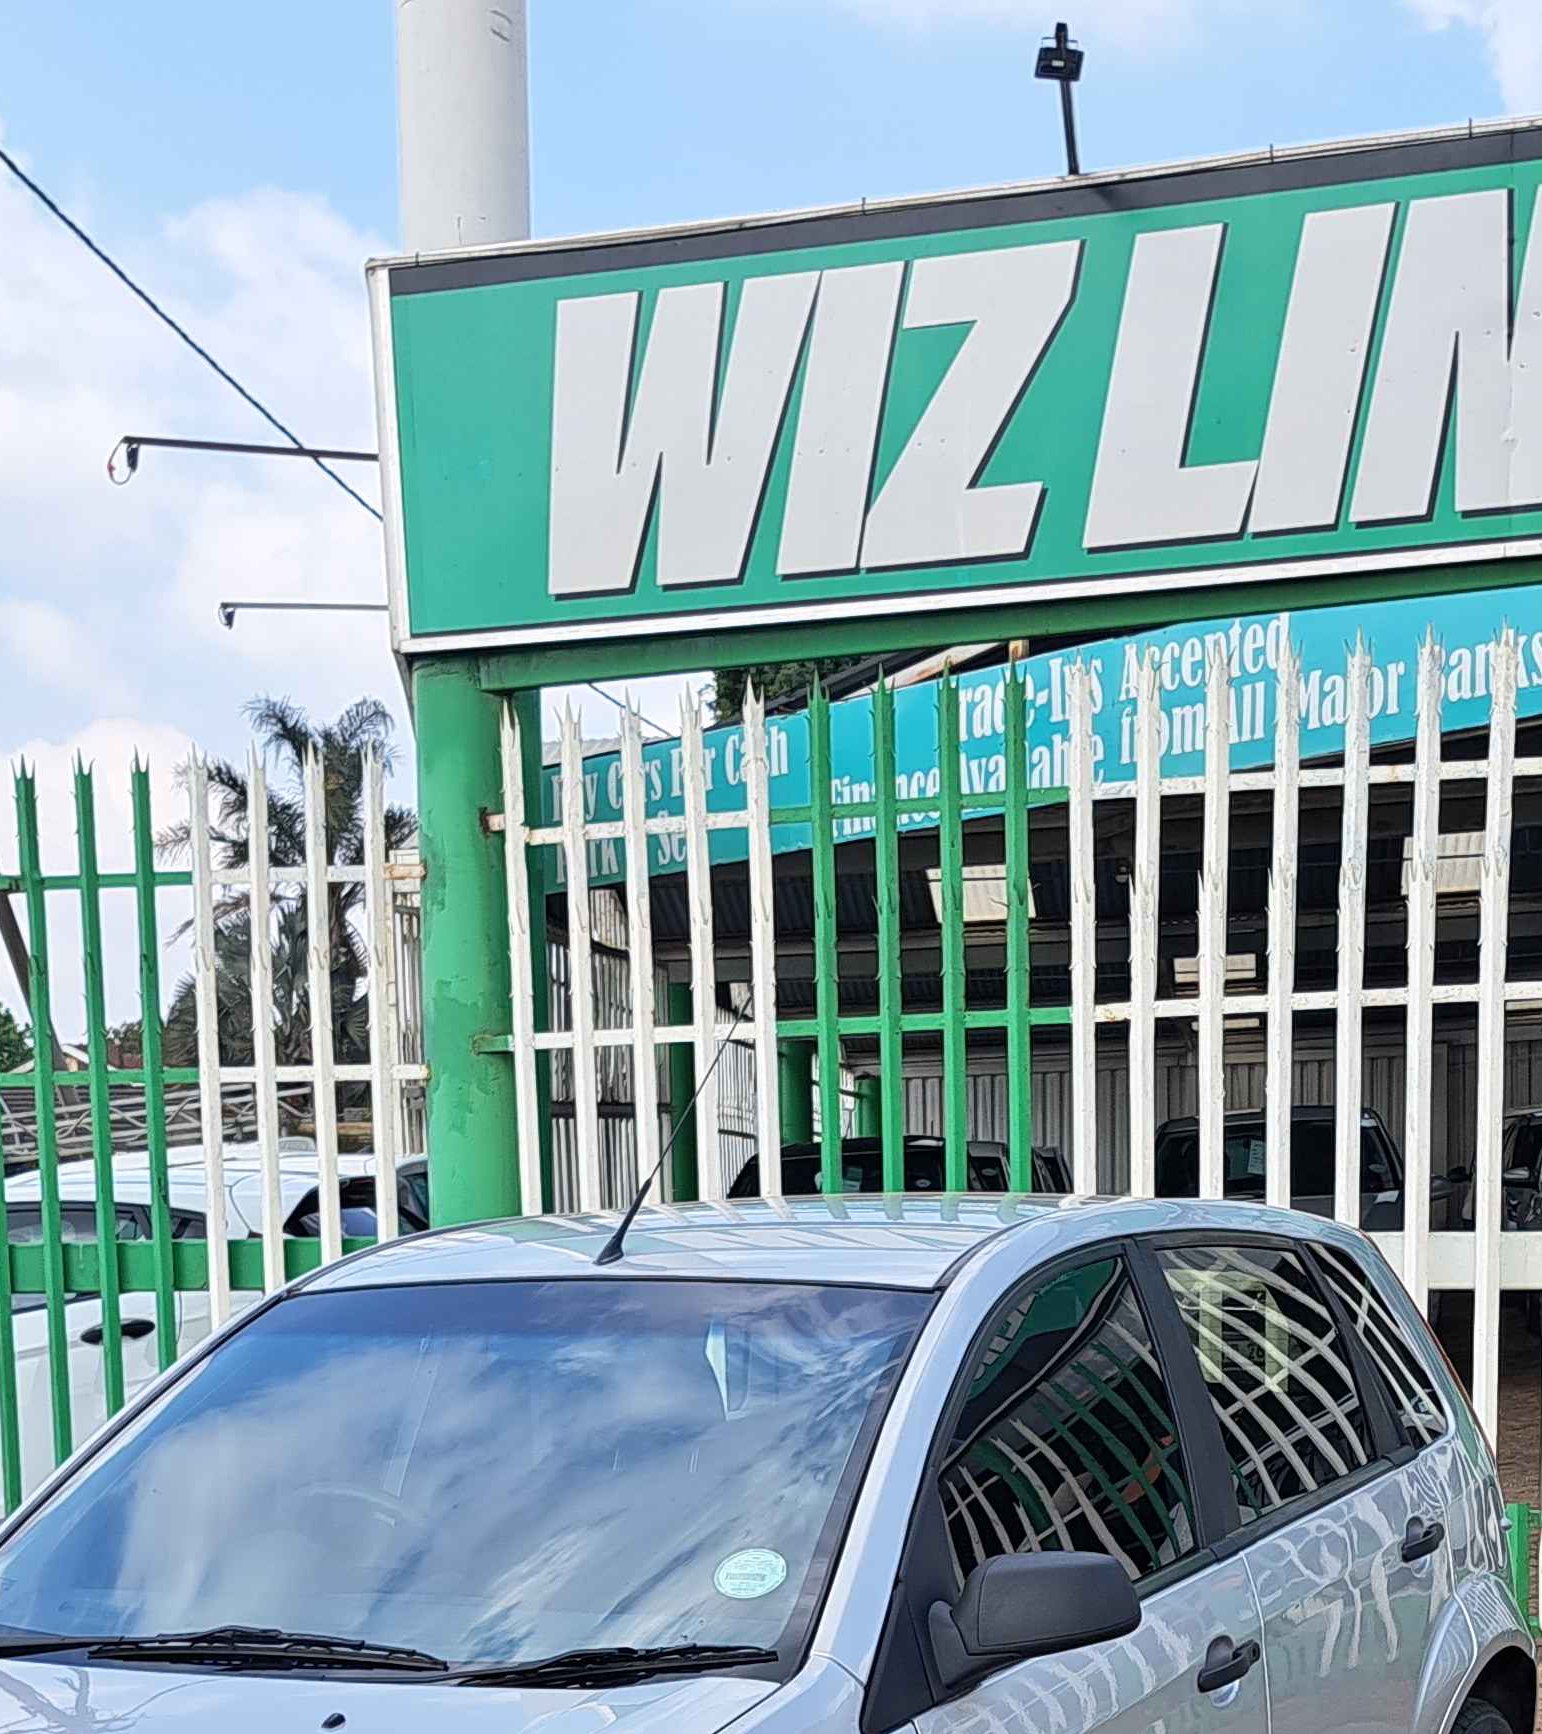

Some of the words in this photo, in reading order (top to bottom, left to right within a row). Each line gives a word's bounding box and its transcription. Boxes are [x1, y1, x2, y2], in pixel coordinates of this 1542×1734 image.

[547, 238, 1084, 598] WIZ
[831, 766, 941, 837] Finnce
[1120, 702, 1205, 765] fom
[1296, 659, 1406, 731] Maor
